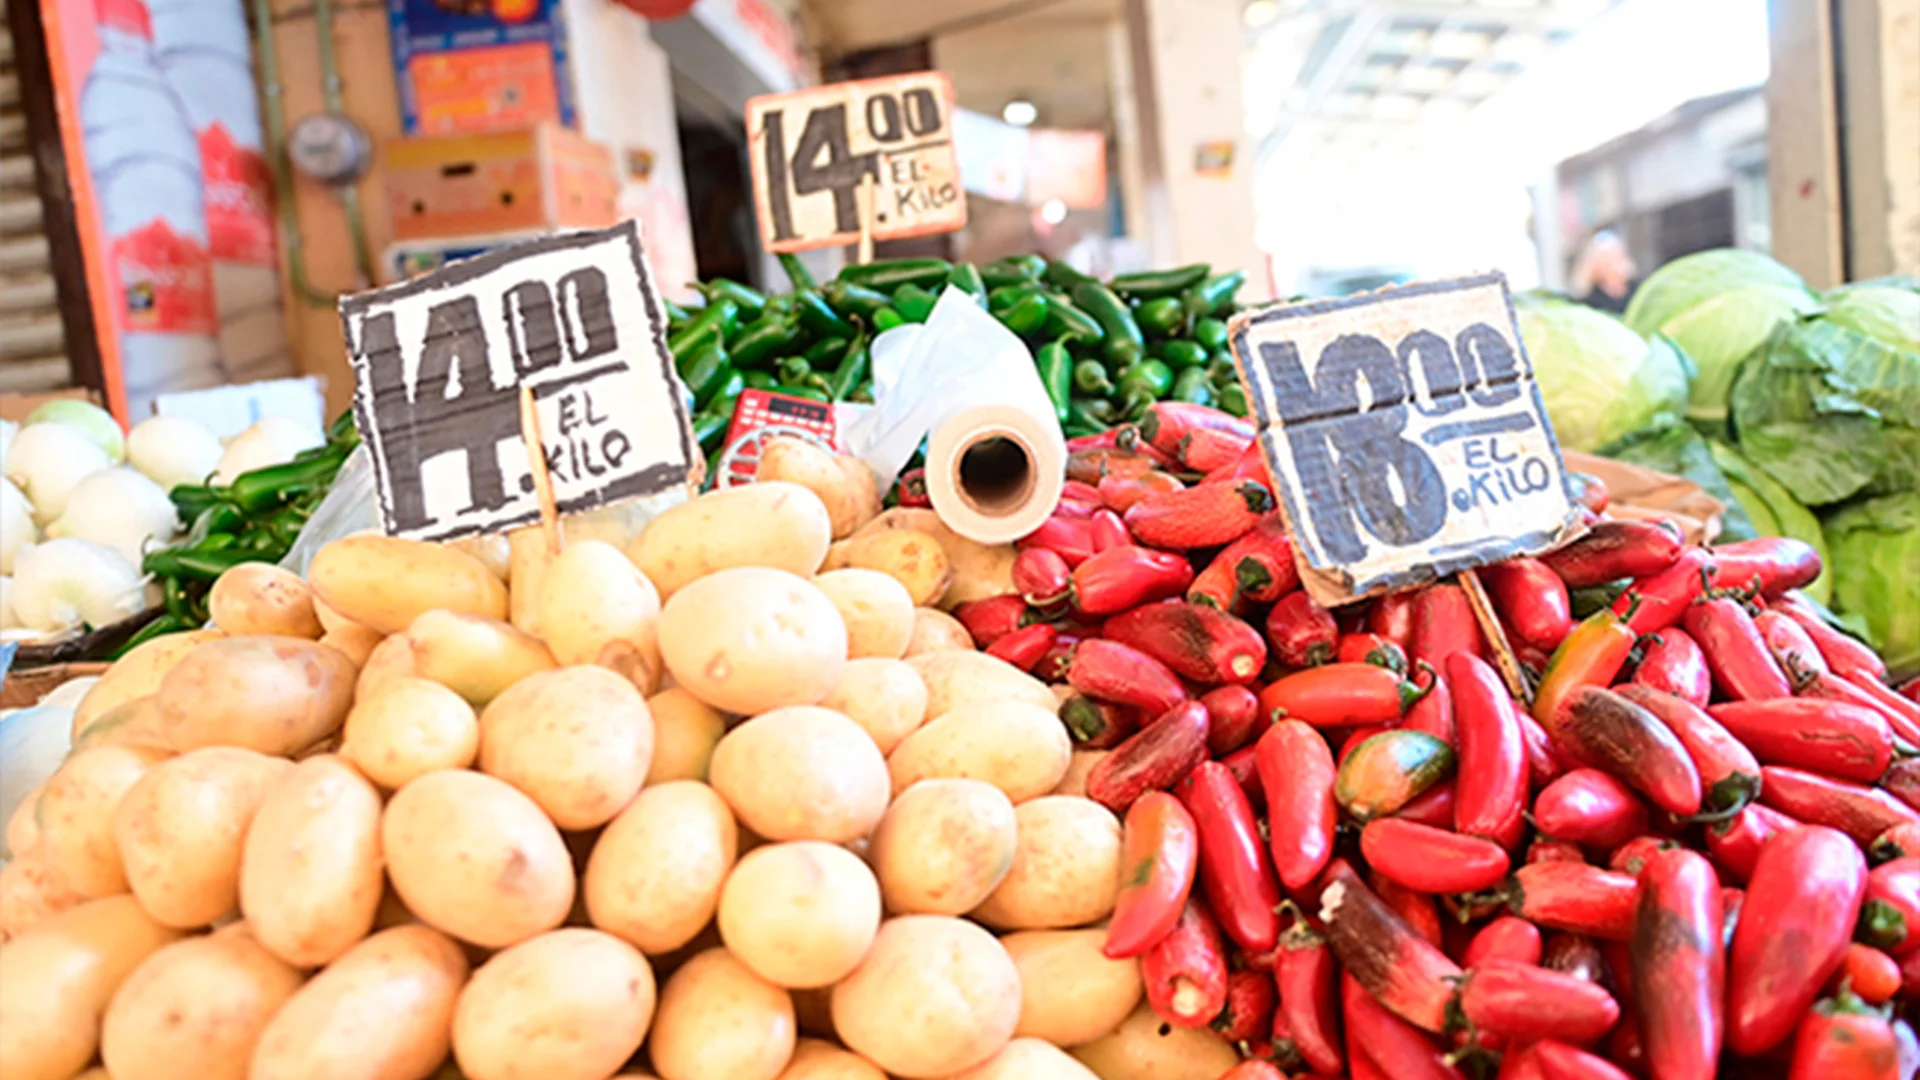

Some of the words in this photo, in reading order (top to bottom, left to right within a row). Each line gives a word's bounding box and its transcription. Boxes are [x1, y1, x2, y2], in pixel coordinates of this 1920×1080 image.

[891, 159, 926, 184] EL
[558, 390, 608, 436] EL
[1463, 437, 1518, 469] EL
